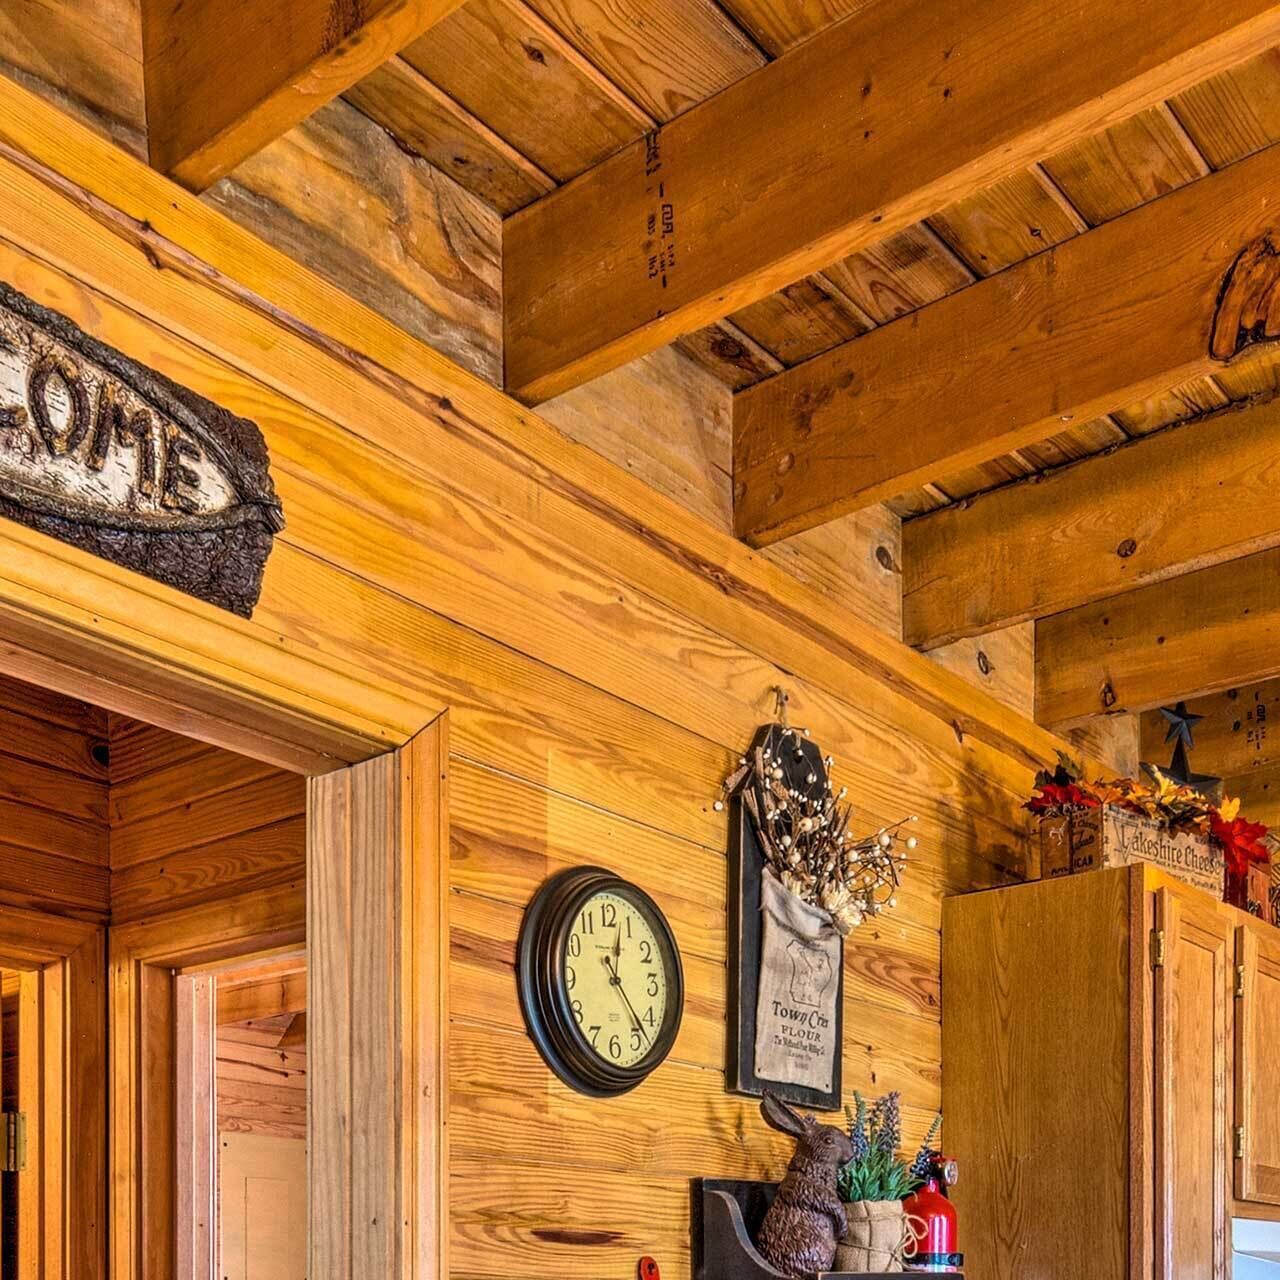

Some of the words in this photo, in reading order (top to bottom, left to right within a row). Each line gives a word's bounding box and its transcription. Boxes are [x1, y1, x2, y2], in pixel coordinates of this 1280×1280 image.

[1185, 846, 1221, 876] Cheese
[581, 910, 593, 934] 11
[601, 904, 616, 928] 12
[627, 915, 632, 938] 1
[640, 940, 652, 964] 2
[647, 973, 658, 997] 3
[642, 1005, 657, 1027] 4
[588, 1026, 602, 1050] 7
[629, 1027, 640, 1052] 5
[781, 1024, 821, 1042] FLOUR
[609, 1034, 621, 1059] 6
